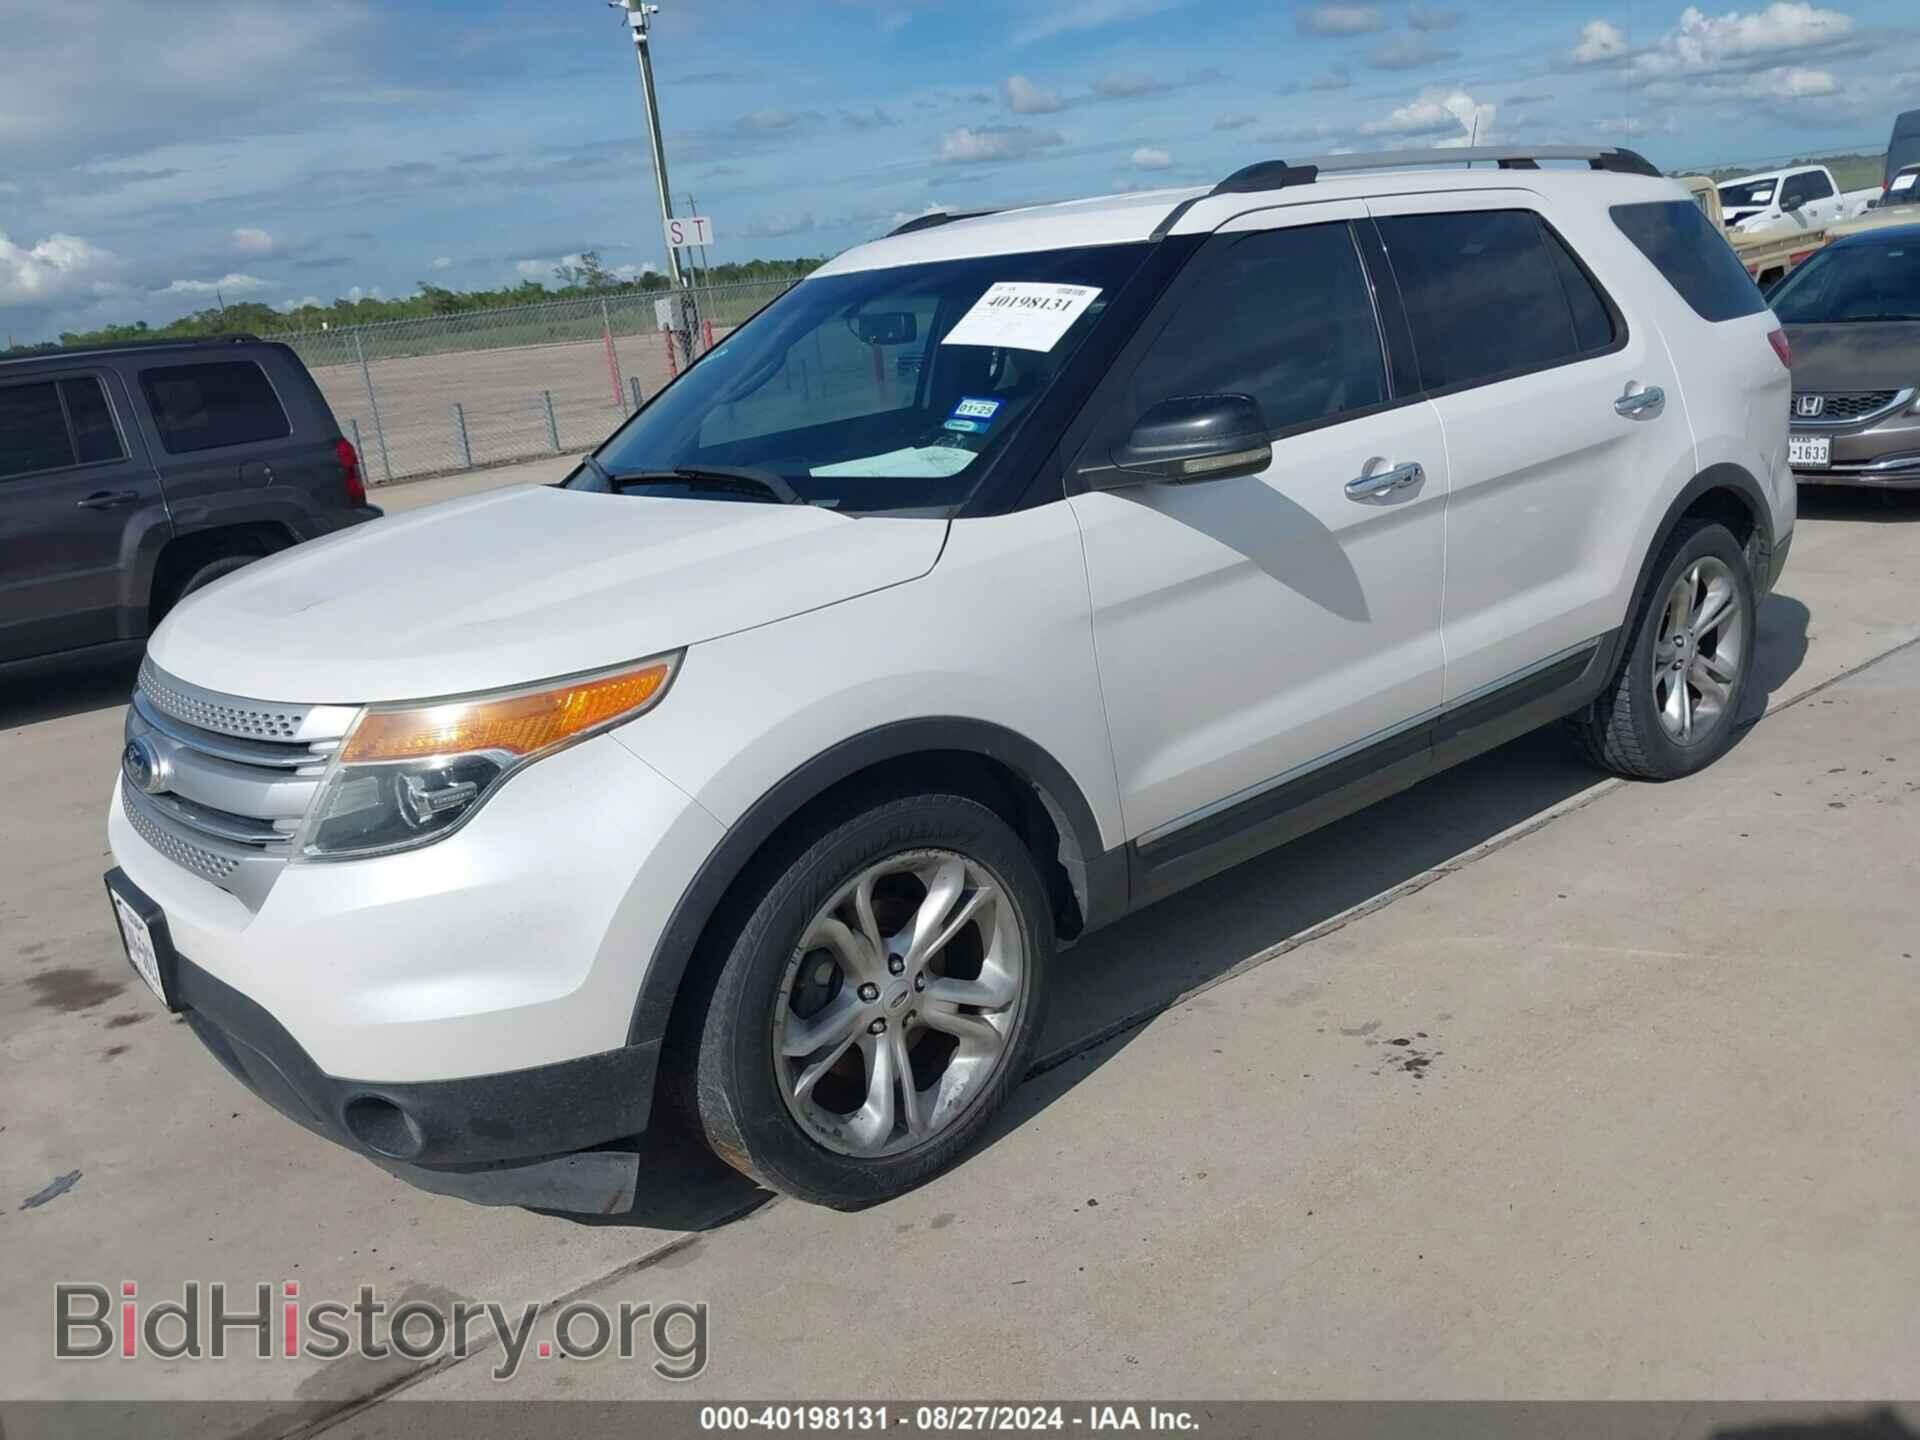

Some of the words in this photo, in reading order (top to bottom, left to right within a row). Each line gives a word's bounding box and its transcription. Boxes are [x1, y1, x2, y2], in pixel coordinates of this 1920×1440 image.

[671, 222, 683, 244] S
[692, 220, 703, 242] T
[988, 295, 1073, 312] 40198131
